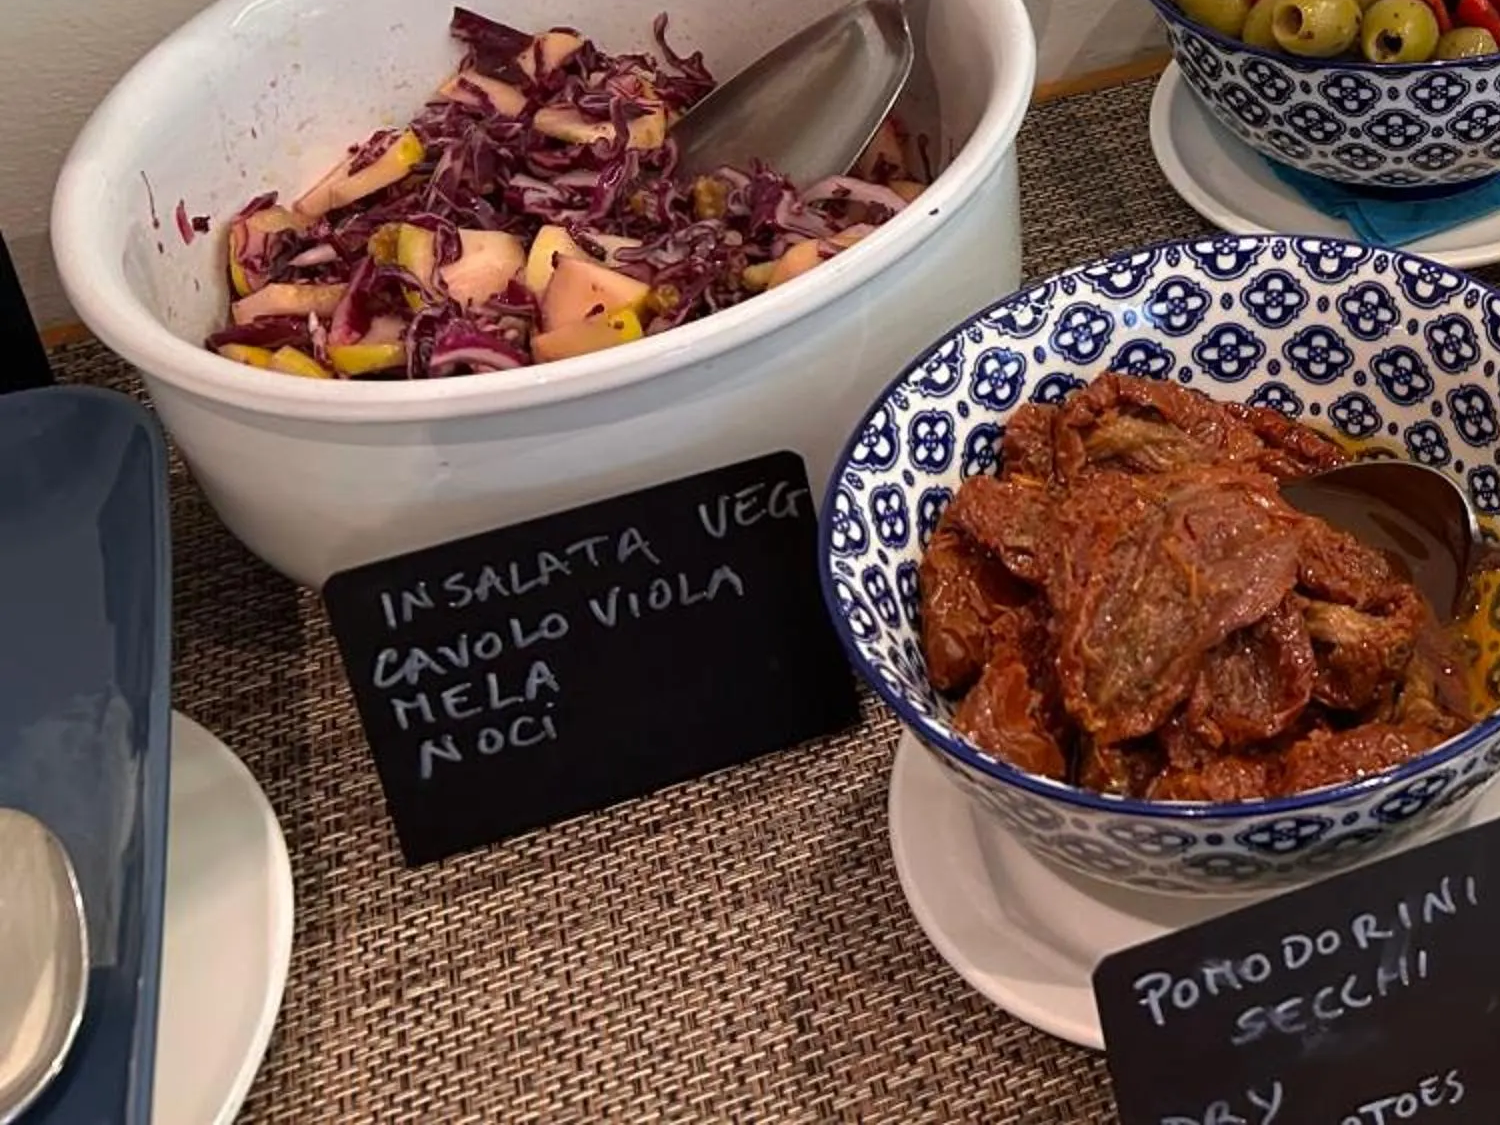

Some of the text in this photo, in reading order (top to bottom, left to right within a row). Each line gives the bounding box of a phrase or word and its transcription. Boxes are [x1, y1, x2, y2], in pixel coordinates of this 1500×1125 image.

[380, 483, 808, 629] INSALATA VEG
[373, 566, 744, 688] CAVOLO VIOLA
[391, 659, 561, 730] MELA
[1134, 875, 1477, 1027] POMODORINI
[1230, 949, 1428, 1046] SECCHI
